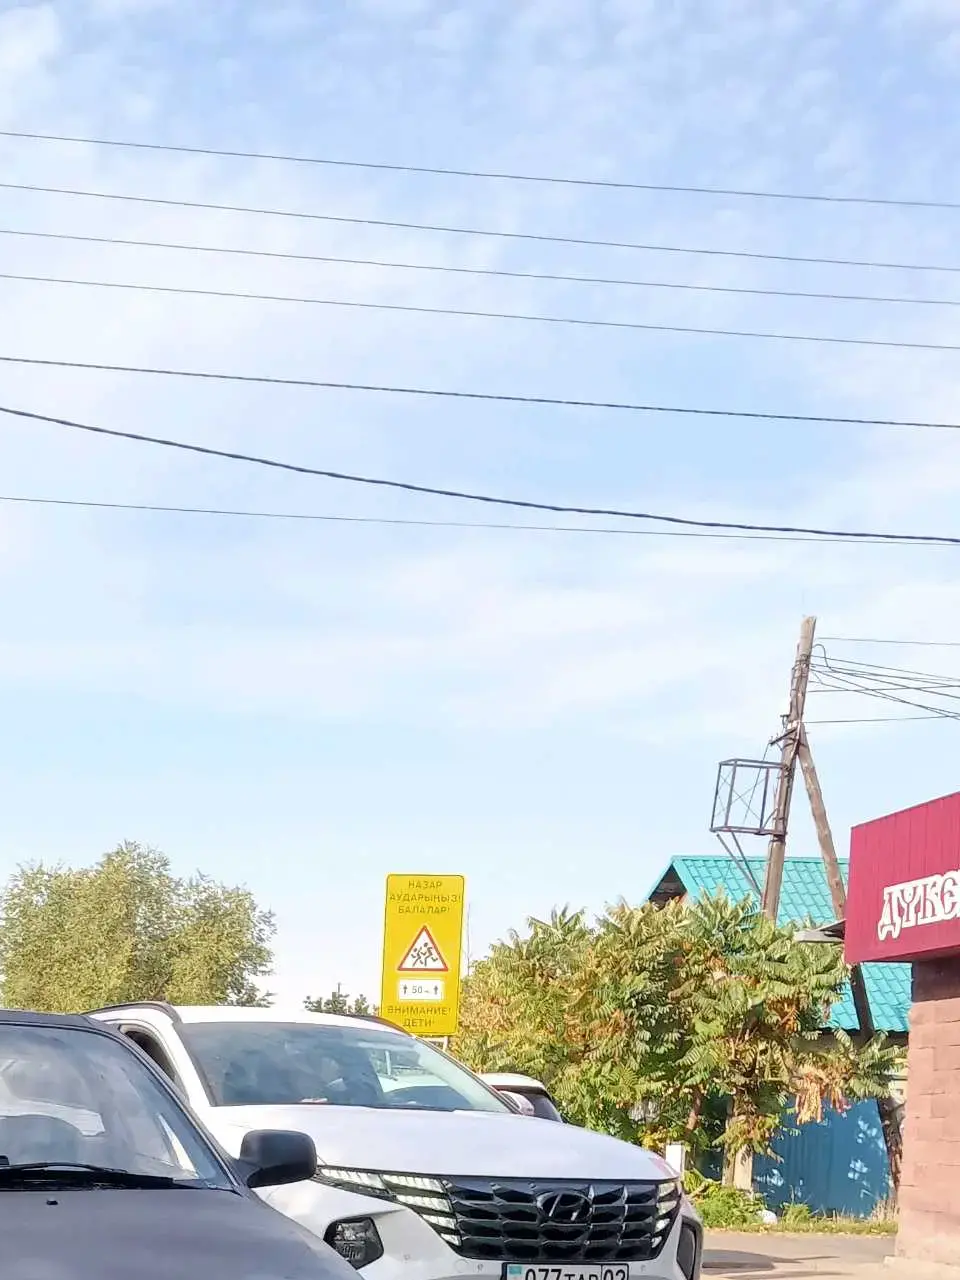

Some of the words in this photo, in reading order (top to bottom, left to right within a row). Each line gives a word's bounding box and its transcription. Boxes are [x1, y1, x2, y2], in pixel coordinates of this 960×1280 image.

[408, 880, 443, 889] НАЗАР
[398, 905, 450, 914] БАЛАЛАР!
[387, 1005, 451, 1016] ВНИМАНИЕ!
